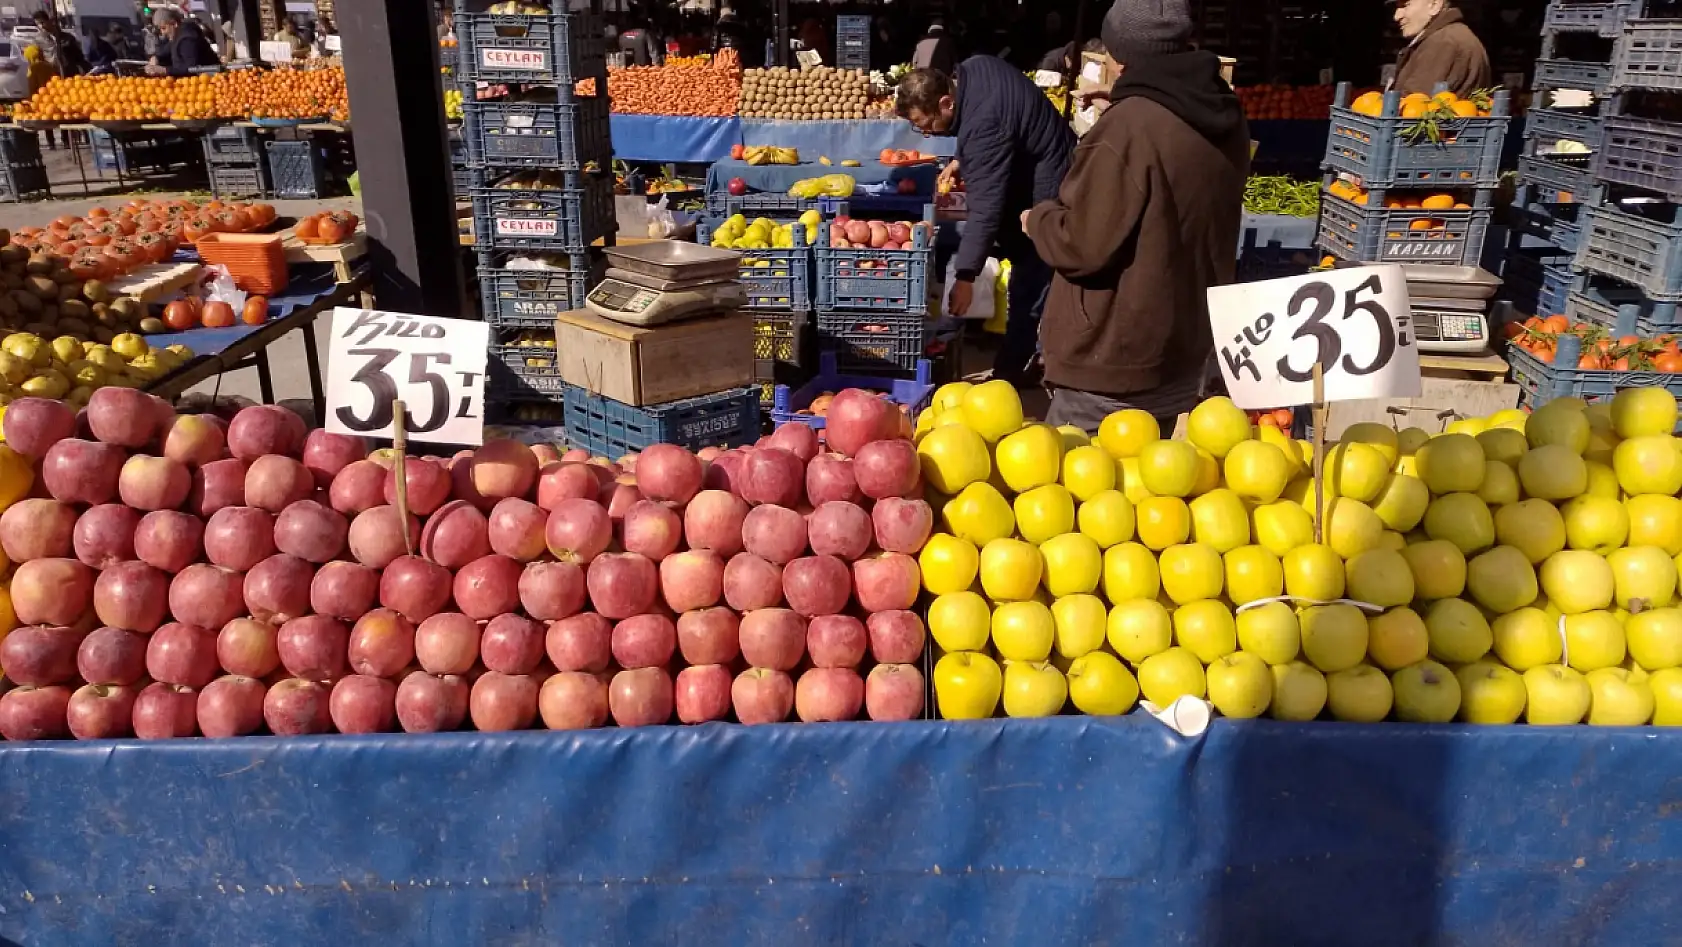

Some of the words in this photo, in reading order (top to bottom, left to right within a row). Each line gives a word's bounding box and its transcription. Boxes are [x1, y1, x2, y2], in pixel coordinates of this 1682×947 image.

[487, 51, 543, 63] CEYLAN
[501, 220, 555, 230] CEYLAN
[1388, 243, 1456, 255] KAPLAN
[1276, 274, 1396, 382] 35
[335, 348, 453, 433] 35
